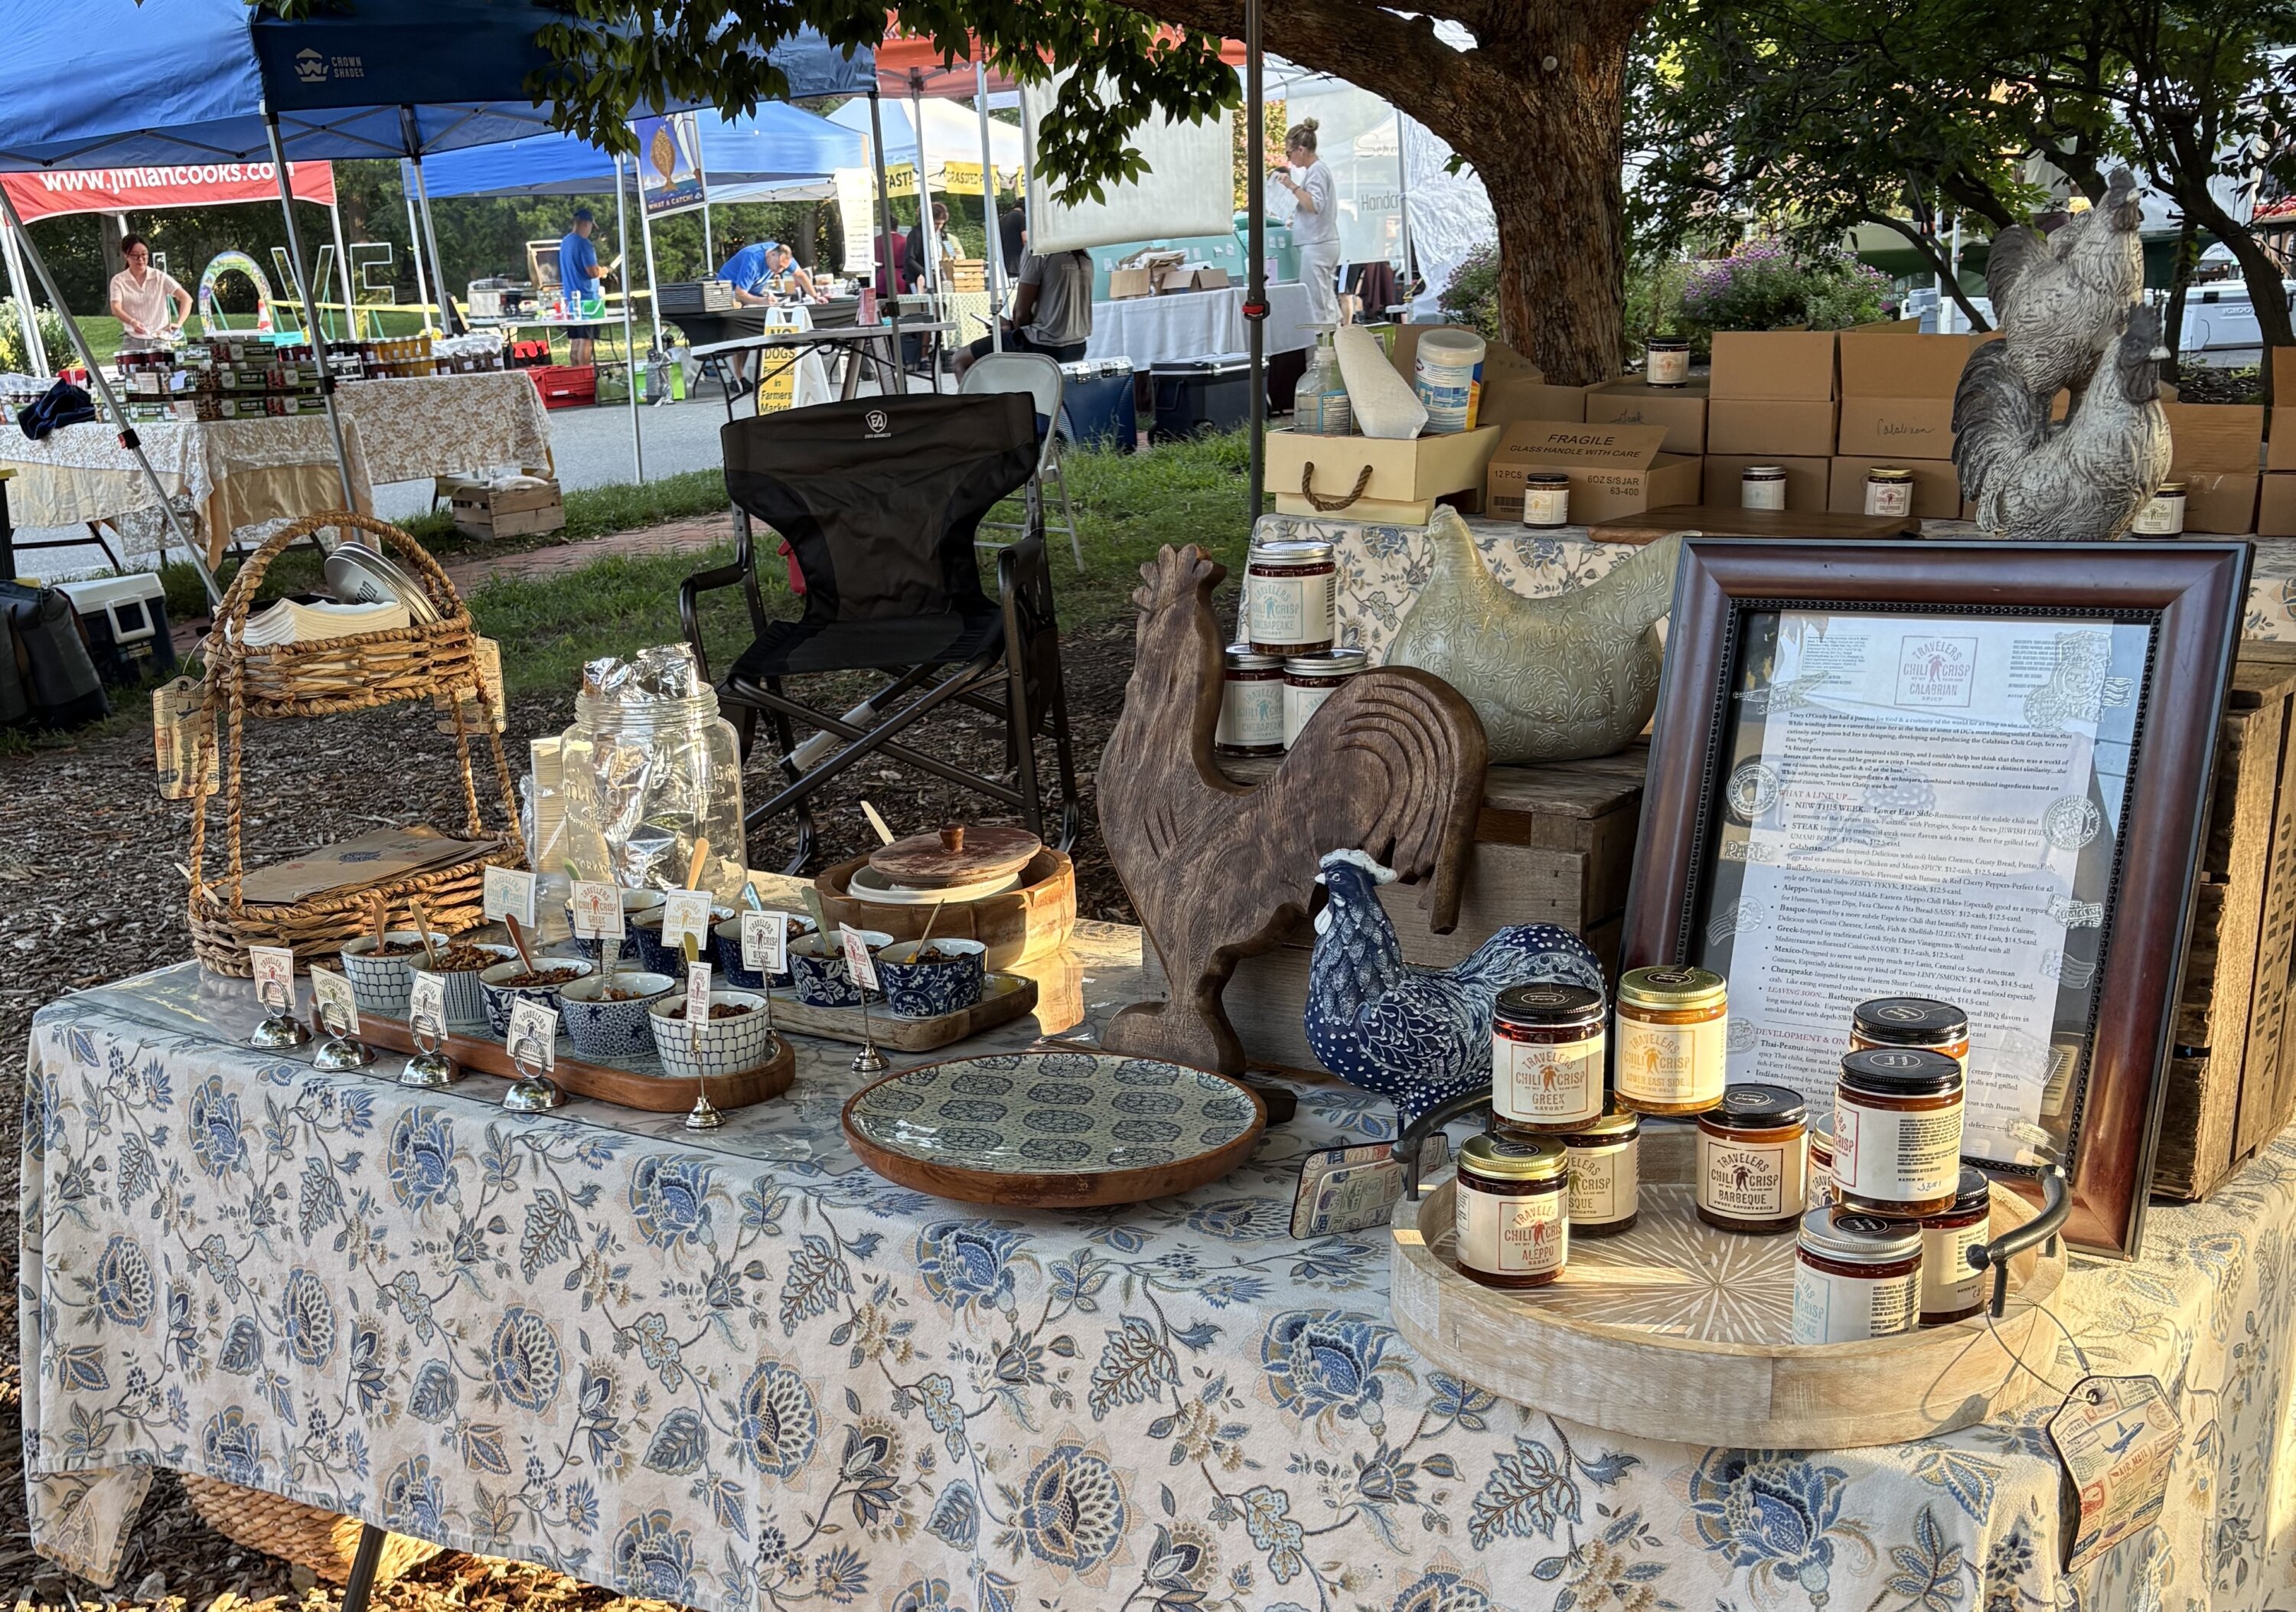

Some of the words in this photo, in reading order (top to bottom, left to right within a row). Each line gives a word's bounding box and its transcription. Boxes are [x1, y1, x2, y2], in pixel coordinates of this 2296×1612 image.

[331, 56, 362, 67] CROWN
[334, 67, 365, 78] SHADES
[647, 200, 664, 210] WHAT
[665, 199, 670, 207] A
[671, 194, 693, 204] CATCH!
[2223, 307, 2252, 315] IGLOO
[765, 347, 795, 359] DOGS
[774, 379, 781, 387] in
[761, 390, 792, 400] Farmers
[1548, 434, 1616, 445] FRAGILE
[1509, 445, 1543, 453] GLASS
[1543, 446, 1583, 455] HANDLE
[1494, 470, 1503, 478] 12
[1505, 471, 1522, 479] PCS
[1622, 478, 1639, 486] JAR
[1609, 488, 1639, 496] 63-400
[1254, 584, 1291, 601] TRAVELERS
[1275, 604, 1300, 614] CRISP
[1253, 621, 1295, 631] CHESAPEAKE
[1913, 640, 1962, 661] TRAVELERS
[1903, 663, 1928, 677] CHILI
[1942, 664, 1971, 677] CRISP
[1910, 683, 1958, 697] CALABRIAN
[1869, 731, 1897, 740] designing,
[1899, 733, 1928, 741] developing
[581, 886, 610, 900] TRAVELERS
[578, 902, 592, 910] CHILI
[599, 902, 617, 912] CRISP
[673, 900, 700, 915] TRAVELERS
[588, 915, 605, 924] GREEK
[748, 919, 774, 934] TRAVELERS
[2255, 813, 2291, 1039] ORCHARD
[746, 935, 757, 945] CHILI
[763, 937, 778, 947] CRISP
[260, 956, 285, 972] TRAVELERS
[1935, 963, 1956, 971] Central
[1967, 965, 1985, 974] South
[1986, 968, 2015, 977] American
[276, 974, 289, 984] CRISP
[319, 978, 346, 997] TRAVELERS
[417, 981, 437, 1000] TRAVELERS
[1768, 986, 1800, 996] LEAVING
[427, 1000, 440, 1013] CRISP
[519, 1010, 546, 1030] TRAVELERS
[514, 1023, 527, 1036] CHILI
[535, 1030, 551, 1044] CRISP
[1756, 1028, 1821, 1043] DEVELOPMENT
[1629, 1033, 1680, 1054] TRAVELERS
[1522, 1051, 1576, 1070] TRAVELERS
[1624, 1050, 1645, 1066] CHILI
[1659, 1057, 1690, 1069] CRISP
[1515, 1072, 1541, 1085] CHILI
[1557, 1071, 1585, 1085] CRISP
[1626, 1072, 1645, 1085] LOWER
[1648, 1077, 1665, 1086] EAST
[1667, 1078, 1685, 1087] SIDE
[1532, 1093, 1565, 1105] GREEK
[1717, 1153, 1769, 1173] TRAVELERS
[1581, 1178, 1611, 1190] CRISP
[1711, 1169, 1733, 1185] CHILI
[1749, 1174, 1779, 1187] CRISP
[1568, 1198, 1593, 1209] SQUE
[1718, 1189, 1766, 1206] BARBEQUE
[1512, 1204, 1557, 1226] TRAVELE
[1504, 1229, 1531, 1242] CHILI
[1545, 1222, 1563, 1238] CRIS
[1522, 1245, 1554, 1261] ALEPPO
[1799, 1298, 1825, 1319] CRISP
[2118, 1462, 2132, 1477] AIR
[2131, 1451, 2149, 1467] MAIL
